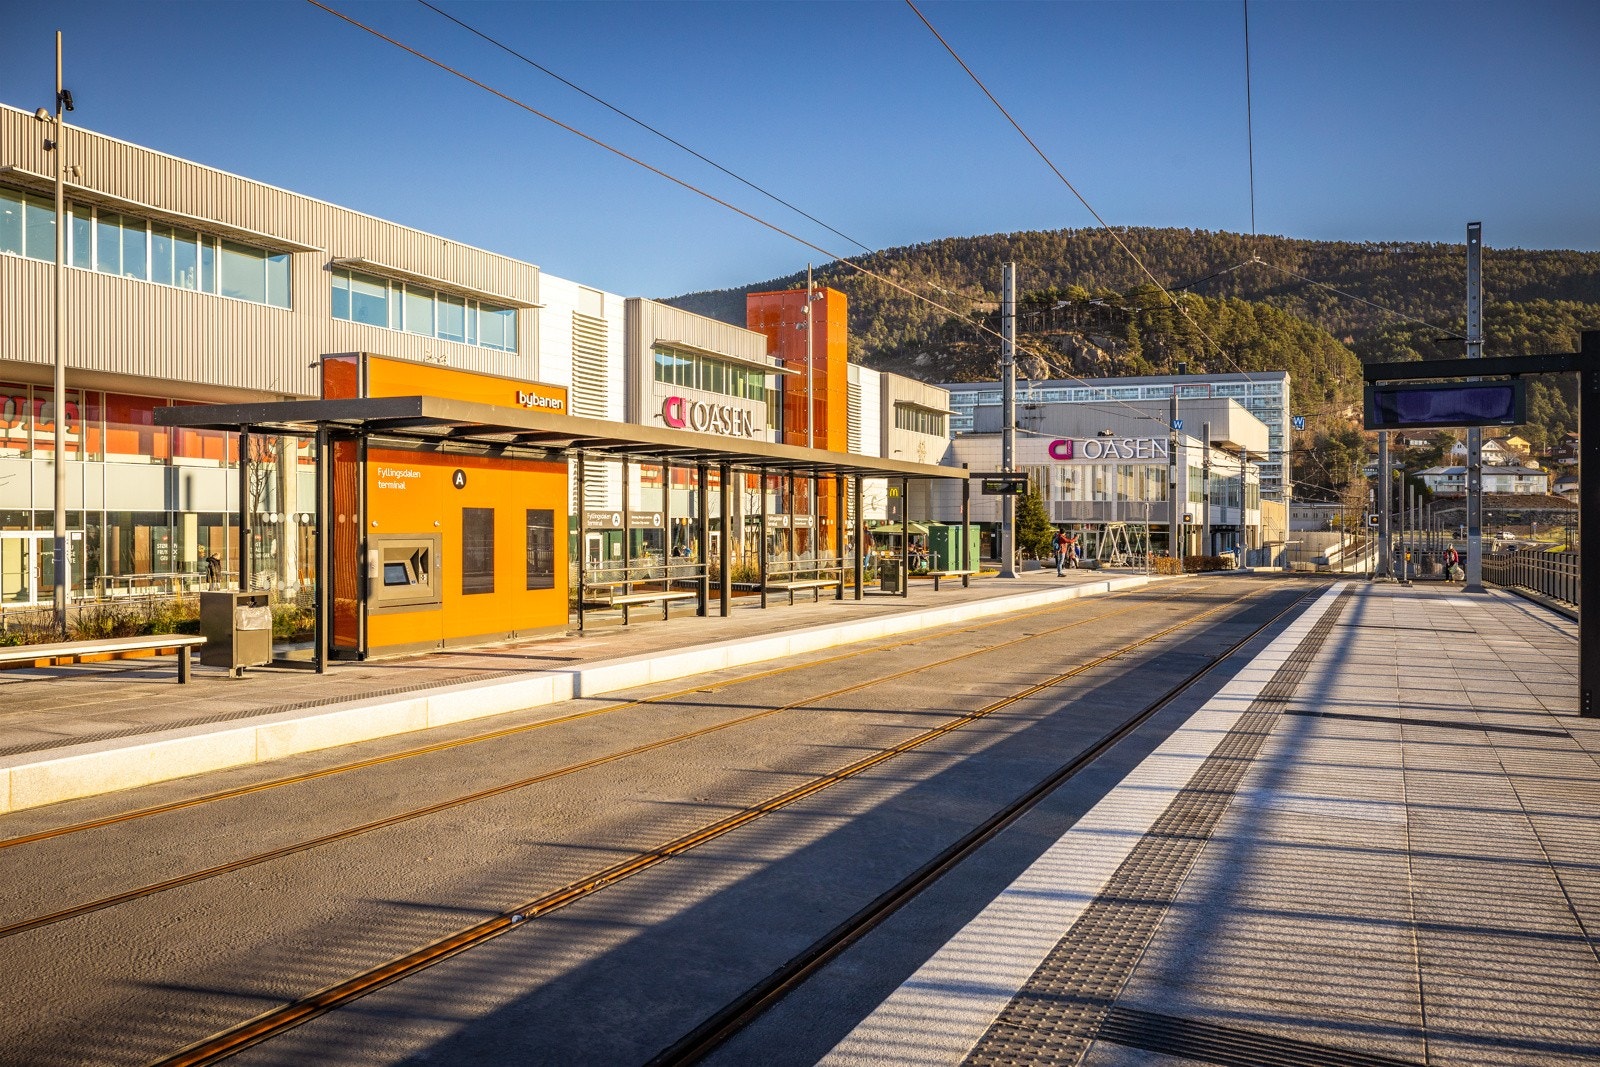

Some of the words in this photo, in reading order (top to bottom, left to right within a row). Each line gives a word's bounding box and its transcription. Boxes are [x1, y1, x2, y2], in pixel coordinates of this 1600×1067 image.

[517, 390, 563, 409] bybanen
[691, 400, 754, 437] OASEN
[1174, 420, 1183, 429] W
[1083, 438, 1168, 459] OASEN
[377, 467, 421, 479] Fyllingsdalen
[455, 472, 464, 485] A
[378, 480, 406, 489] terminal
